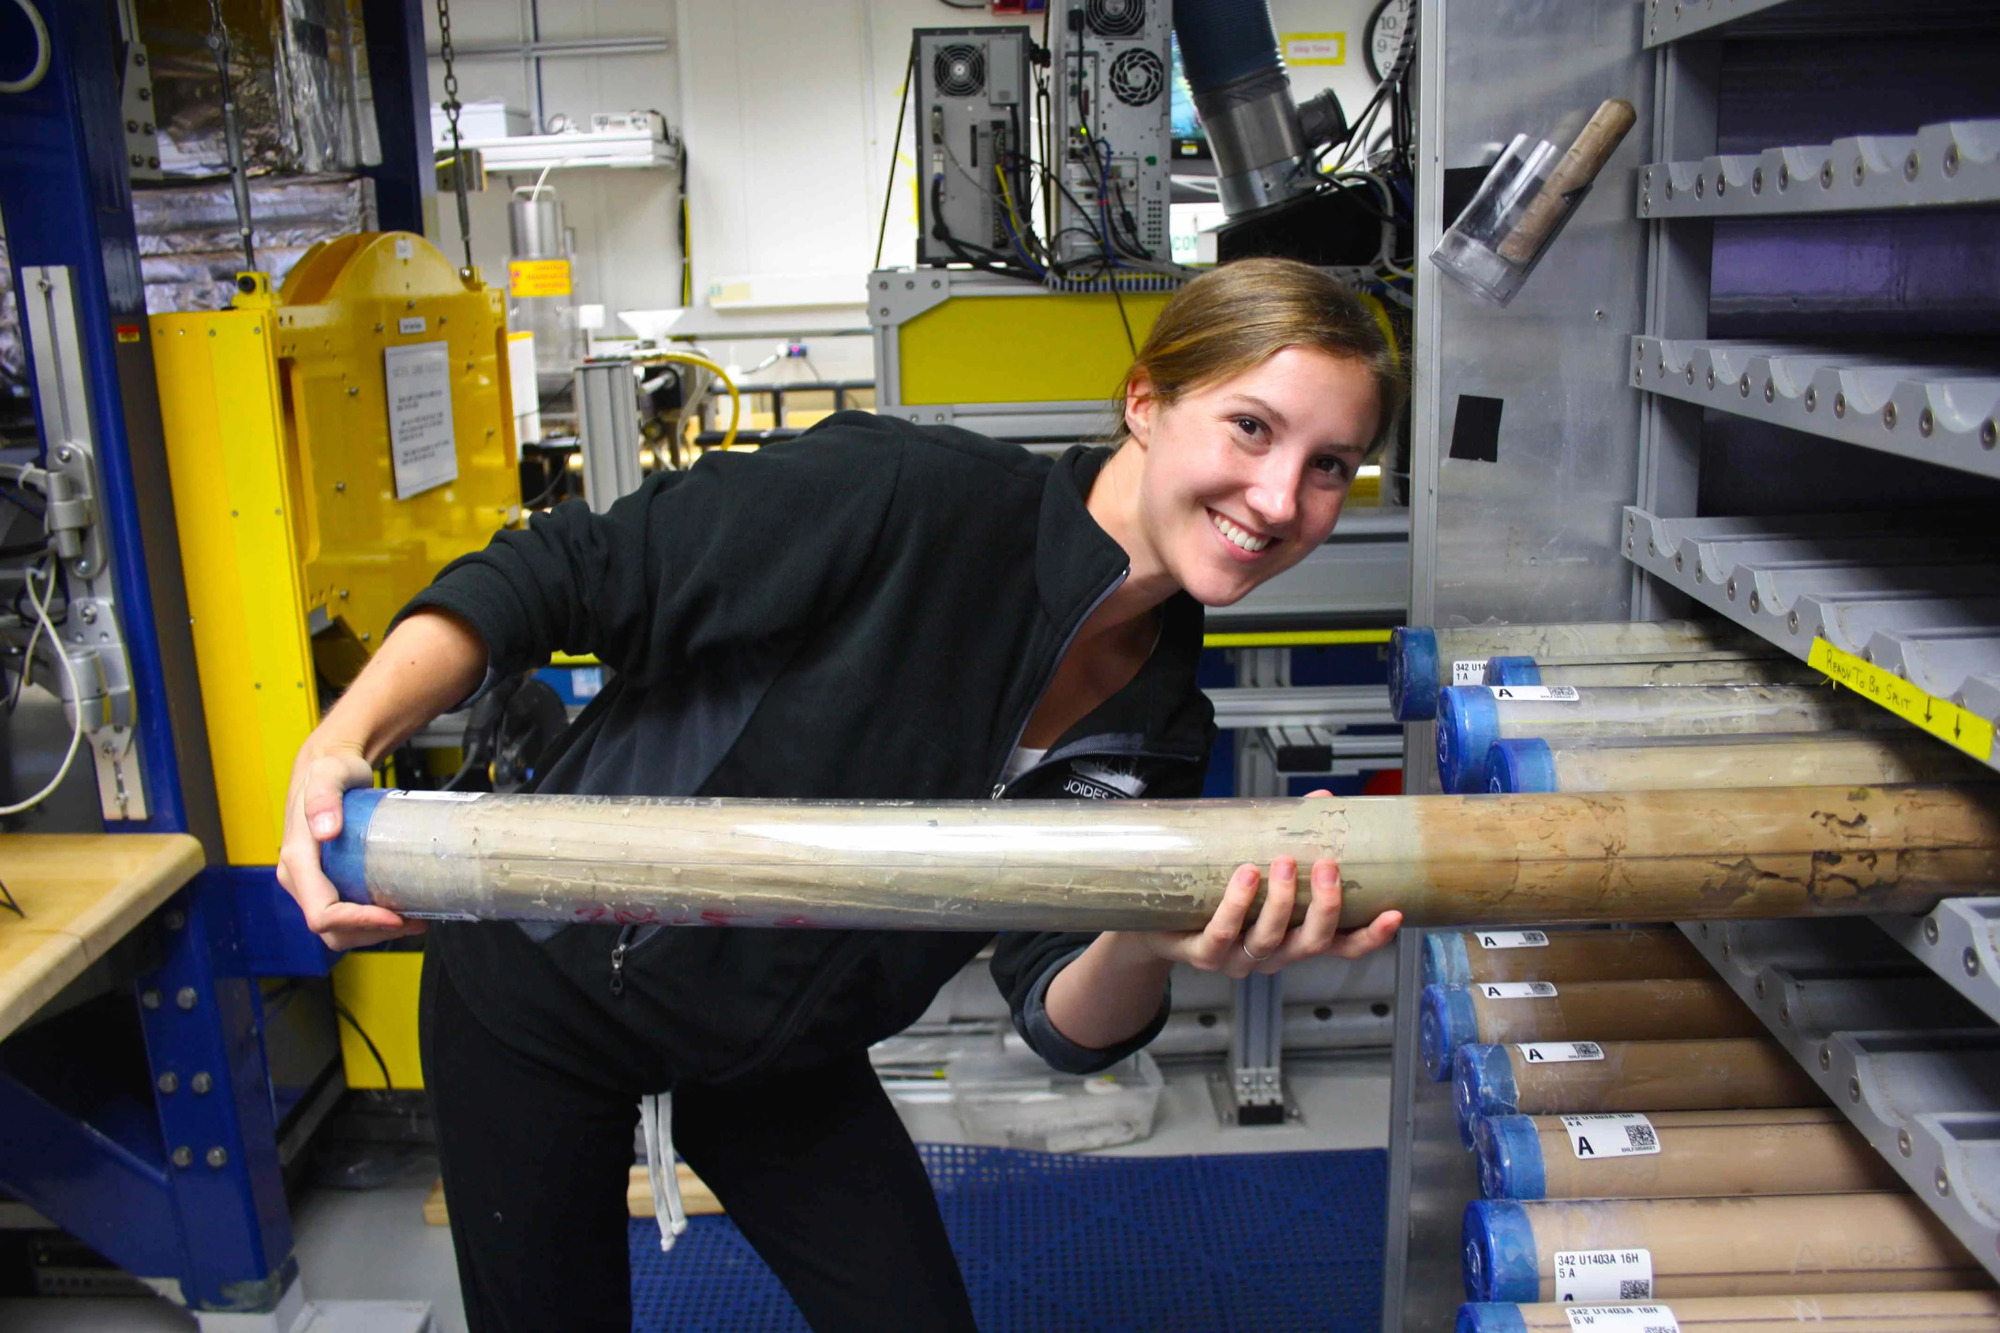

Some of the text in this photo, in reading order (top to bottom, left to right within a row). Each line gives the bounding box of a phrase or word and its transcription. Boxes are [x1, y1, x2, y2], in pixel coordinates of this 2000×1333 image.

[1380, 16, 1397, 30] 10
[1377, 39, 1387, 53] 9
[1455, 663, 1469, 671] 342
[1499, 688, 1514, 698] A
[1063, 779, 1110, 800] JOIDES
[1484, 936, 1497, 947] A
[1488, 986, 1502, 996] A
[1529, 1048, 1544, 1060] A
[1578, 1136, 1595, 1156] A
[1558, 1253, 1639, 1266] 342 U1403A 16H
[1559, 1268, 1576, 1279] 5 A
[1570, 1306, 1659, 1316] 342 U1403A 16H
[1573, 1315, 1595, 1325] 6 W
